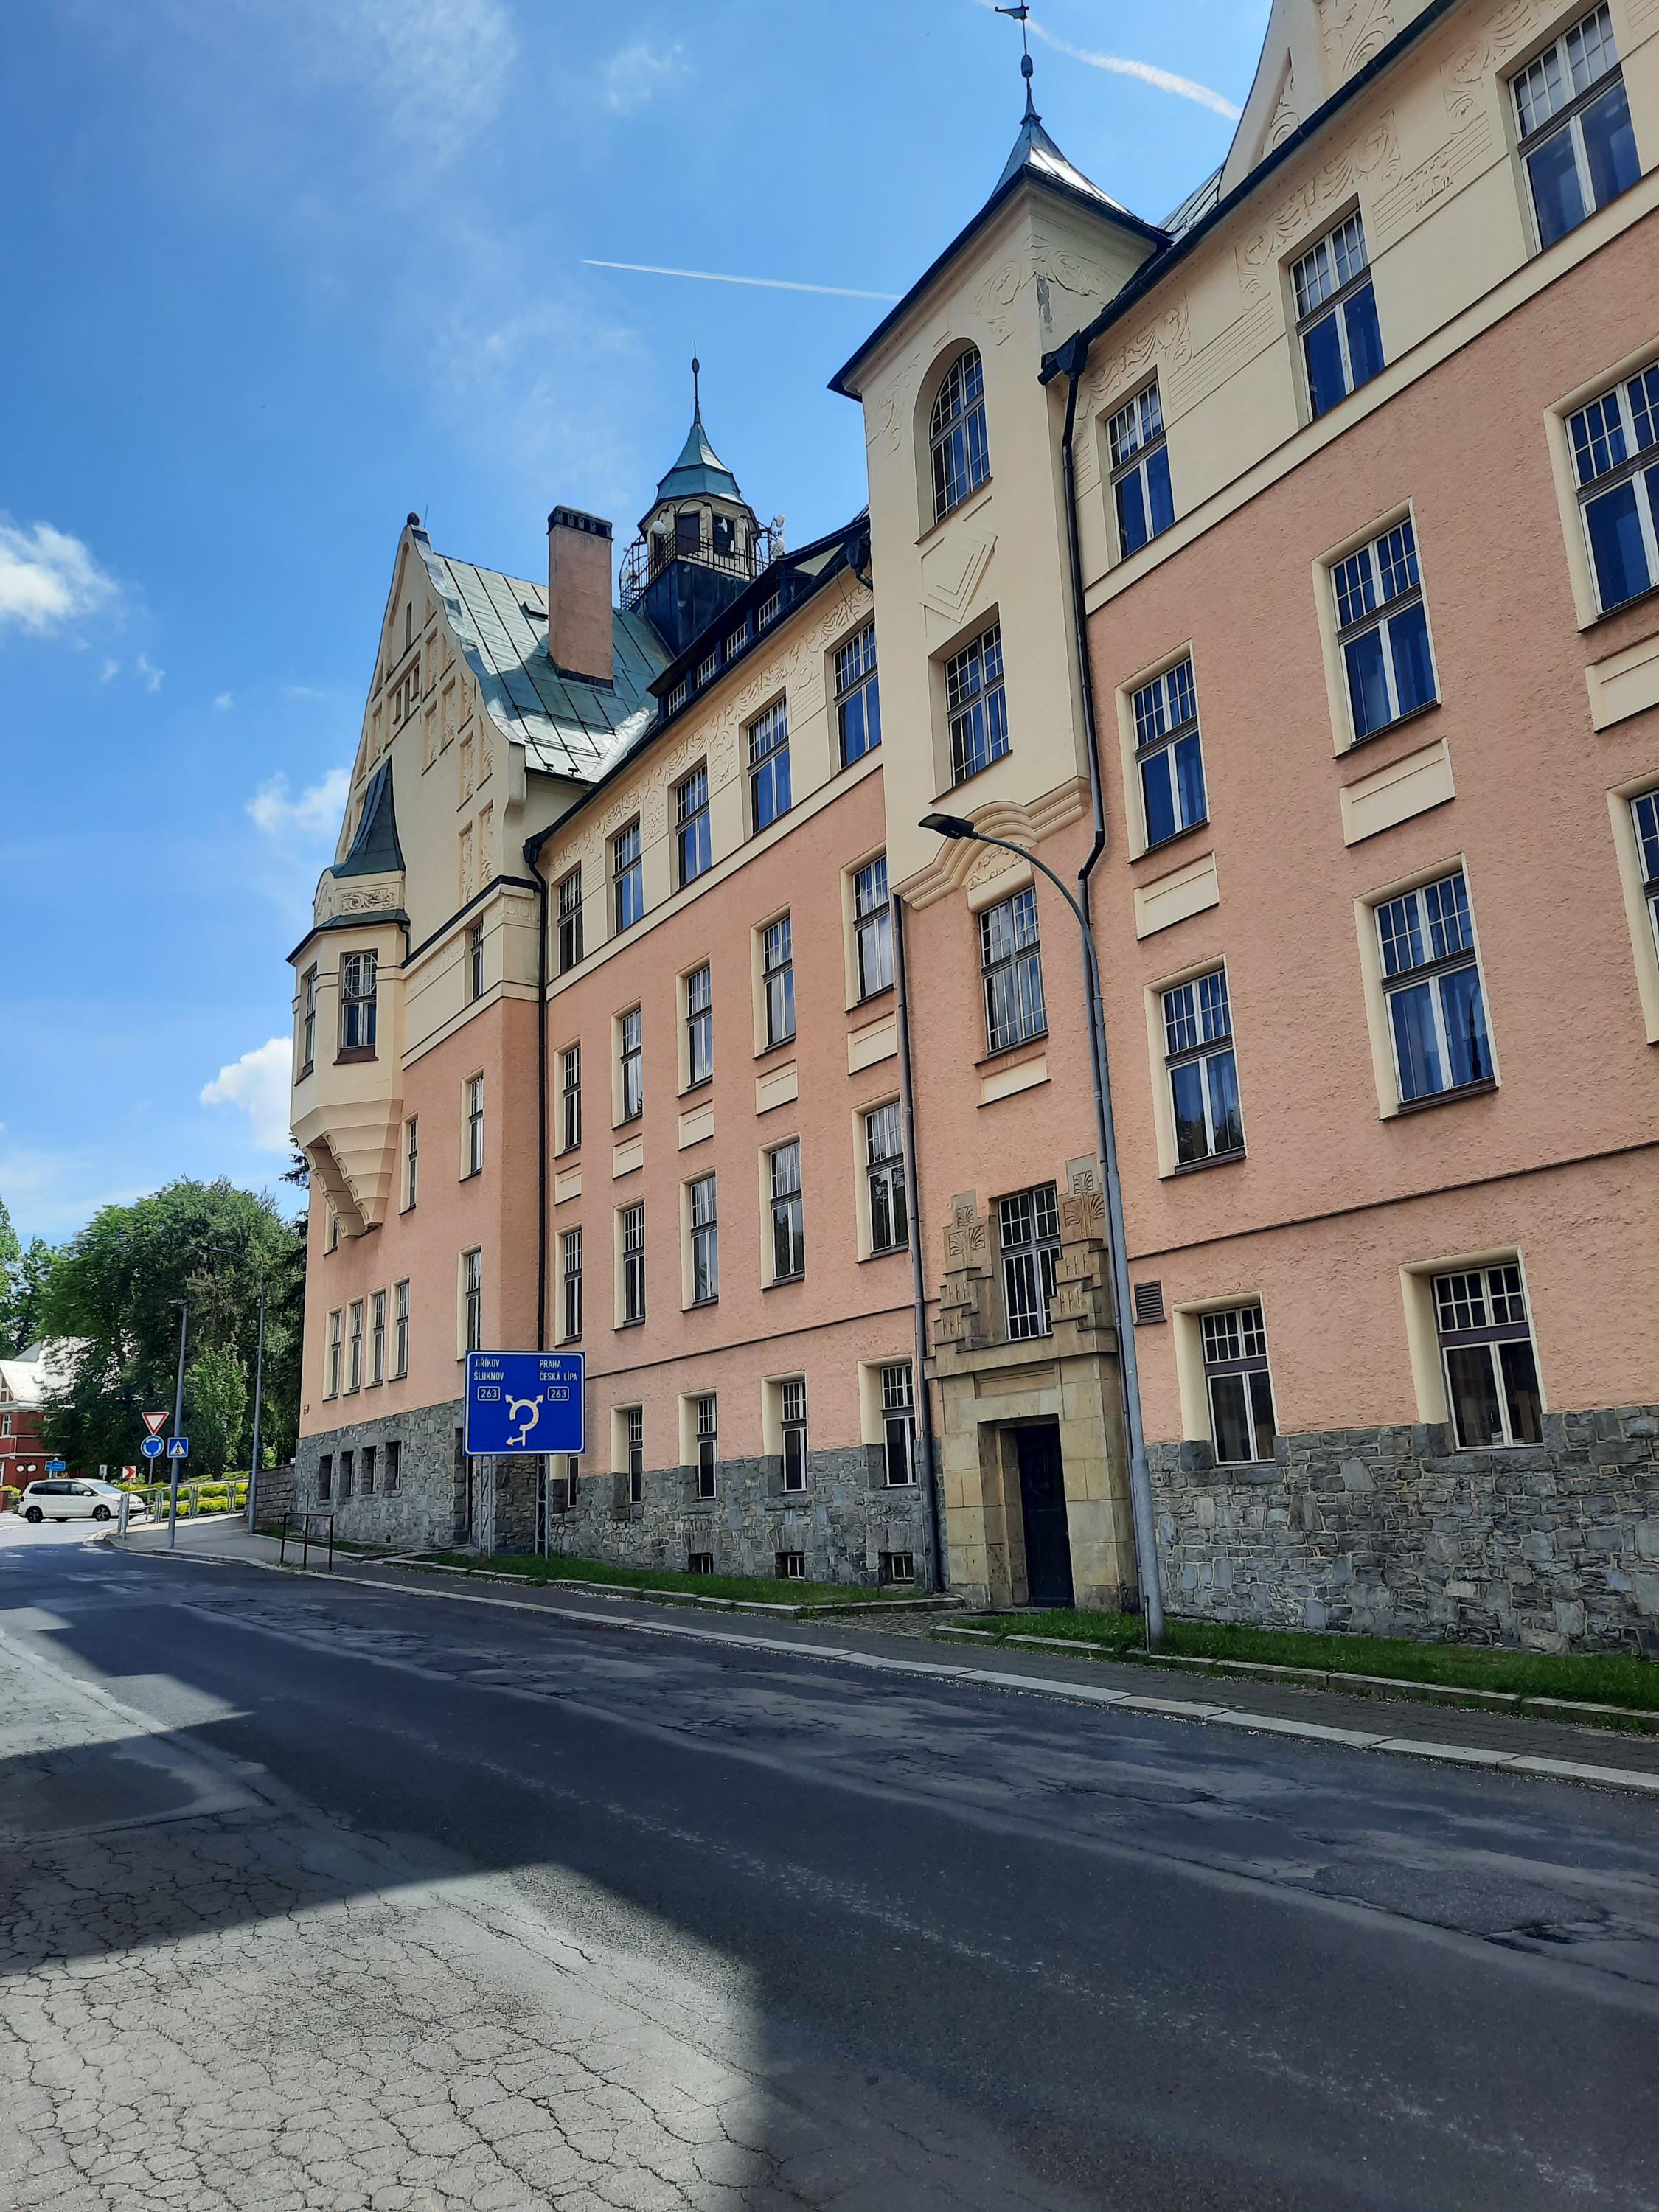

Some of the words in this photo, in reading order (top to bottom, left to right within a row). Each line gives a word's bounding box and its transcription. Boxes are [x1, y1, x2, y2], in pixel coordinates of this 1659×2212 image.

[474, 1357, 501, 1368] JIŘÍKOV
[539, 1359, 562, 1368] PRAHA
[473, 1370, 504, 1381] ŠLUKNOV
[539, 1371, 561, 1381] ČESKÁ
[563, 1371, 578, 1381] LÍPA
[480, 1388, 497, 1399] 263
[551, 1388, 566, 1399] 263
